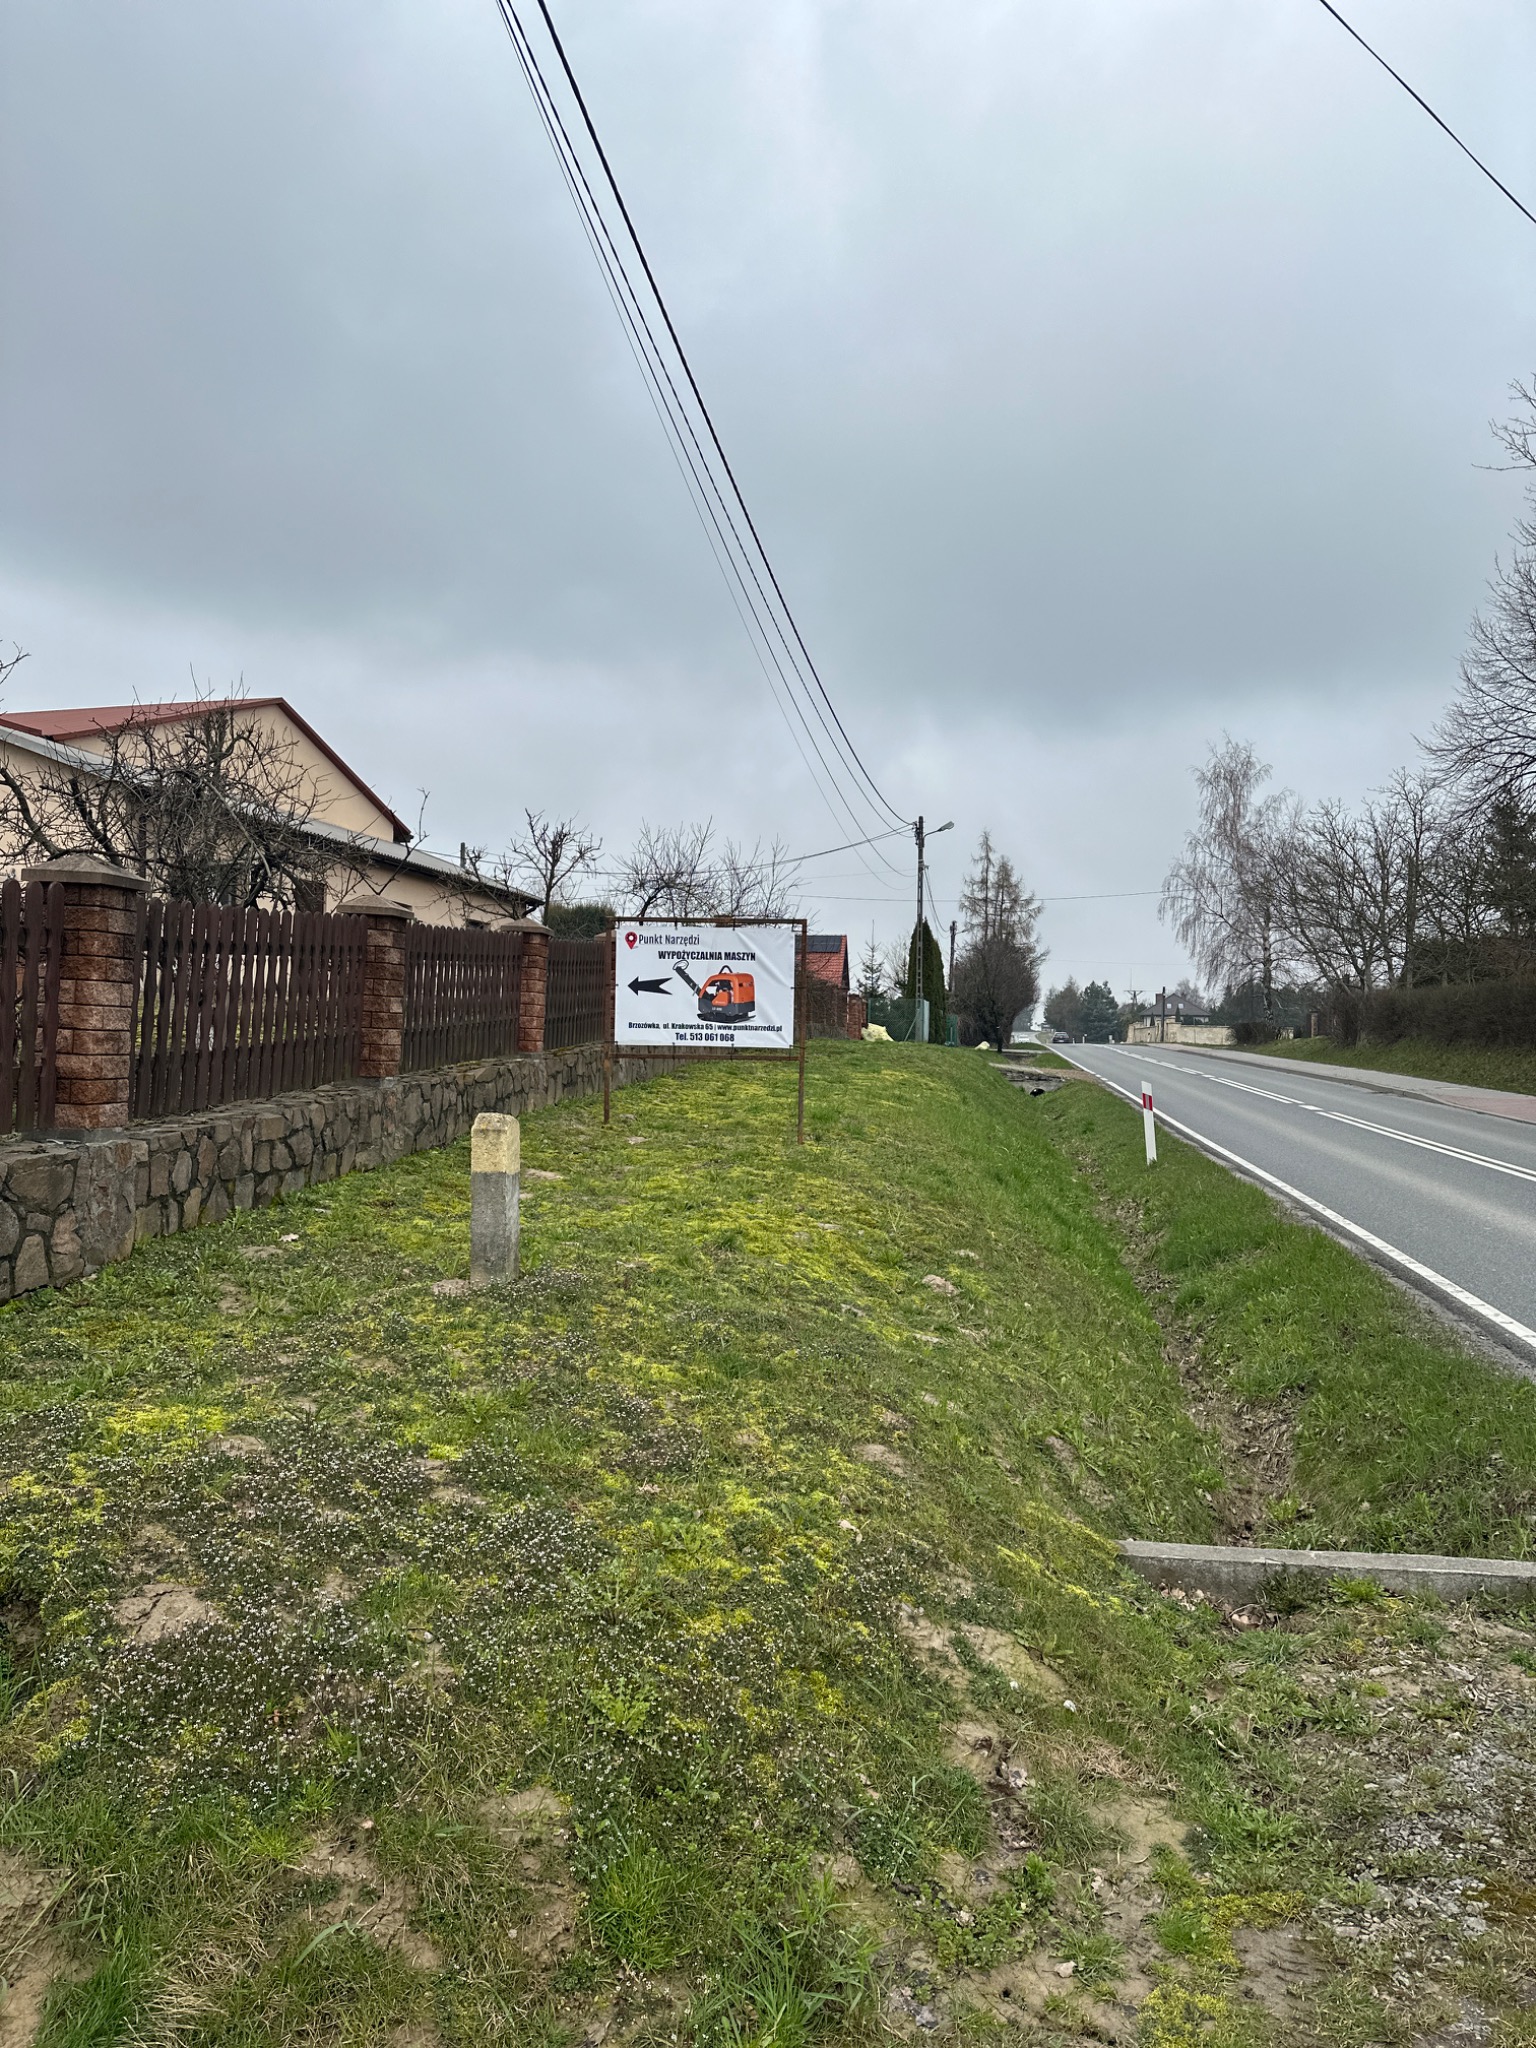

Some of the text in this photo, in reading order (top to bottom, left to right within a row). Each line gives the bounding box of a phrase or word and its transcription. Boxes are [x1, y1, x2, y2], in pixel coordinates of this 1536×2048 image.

[638, 934, 700, 946] Punkt Narzędzi
[658, 950, 756, 961] WYPOŻYCZALNIA MASZYN
[717, 1024, 783, 1032] www.punktnarzedzi.pl
[675, 1032, 735, 1042] Tel. 513 061 068
